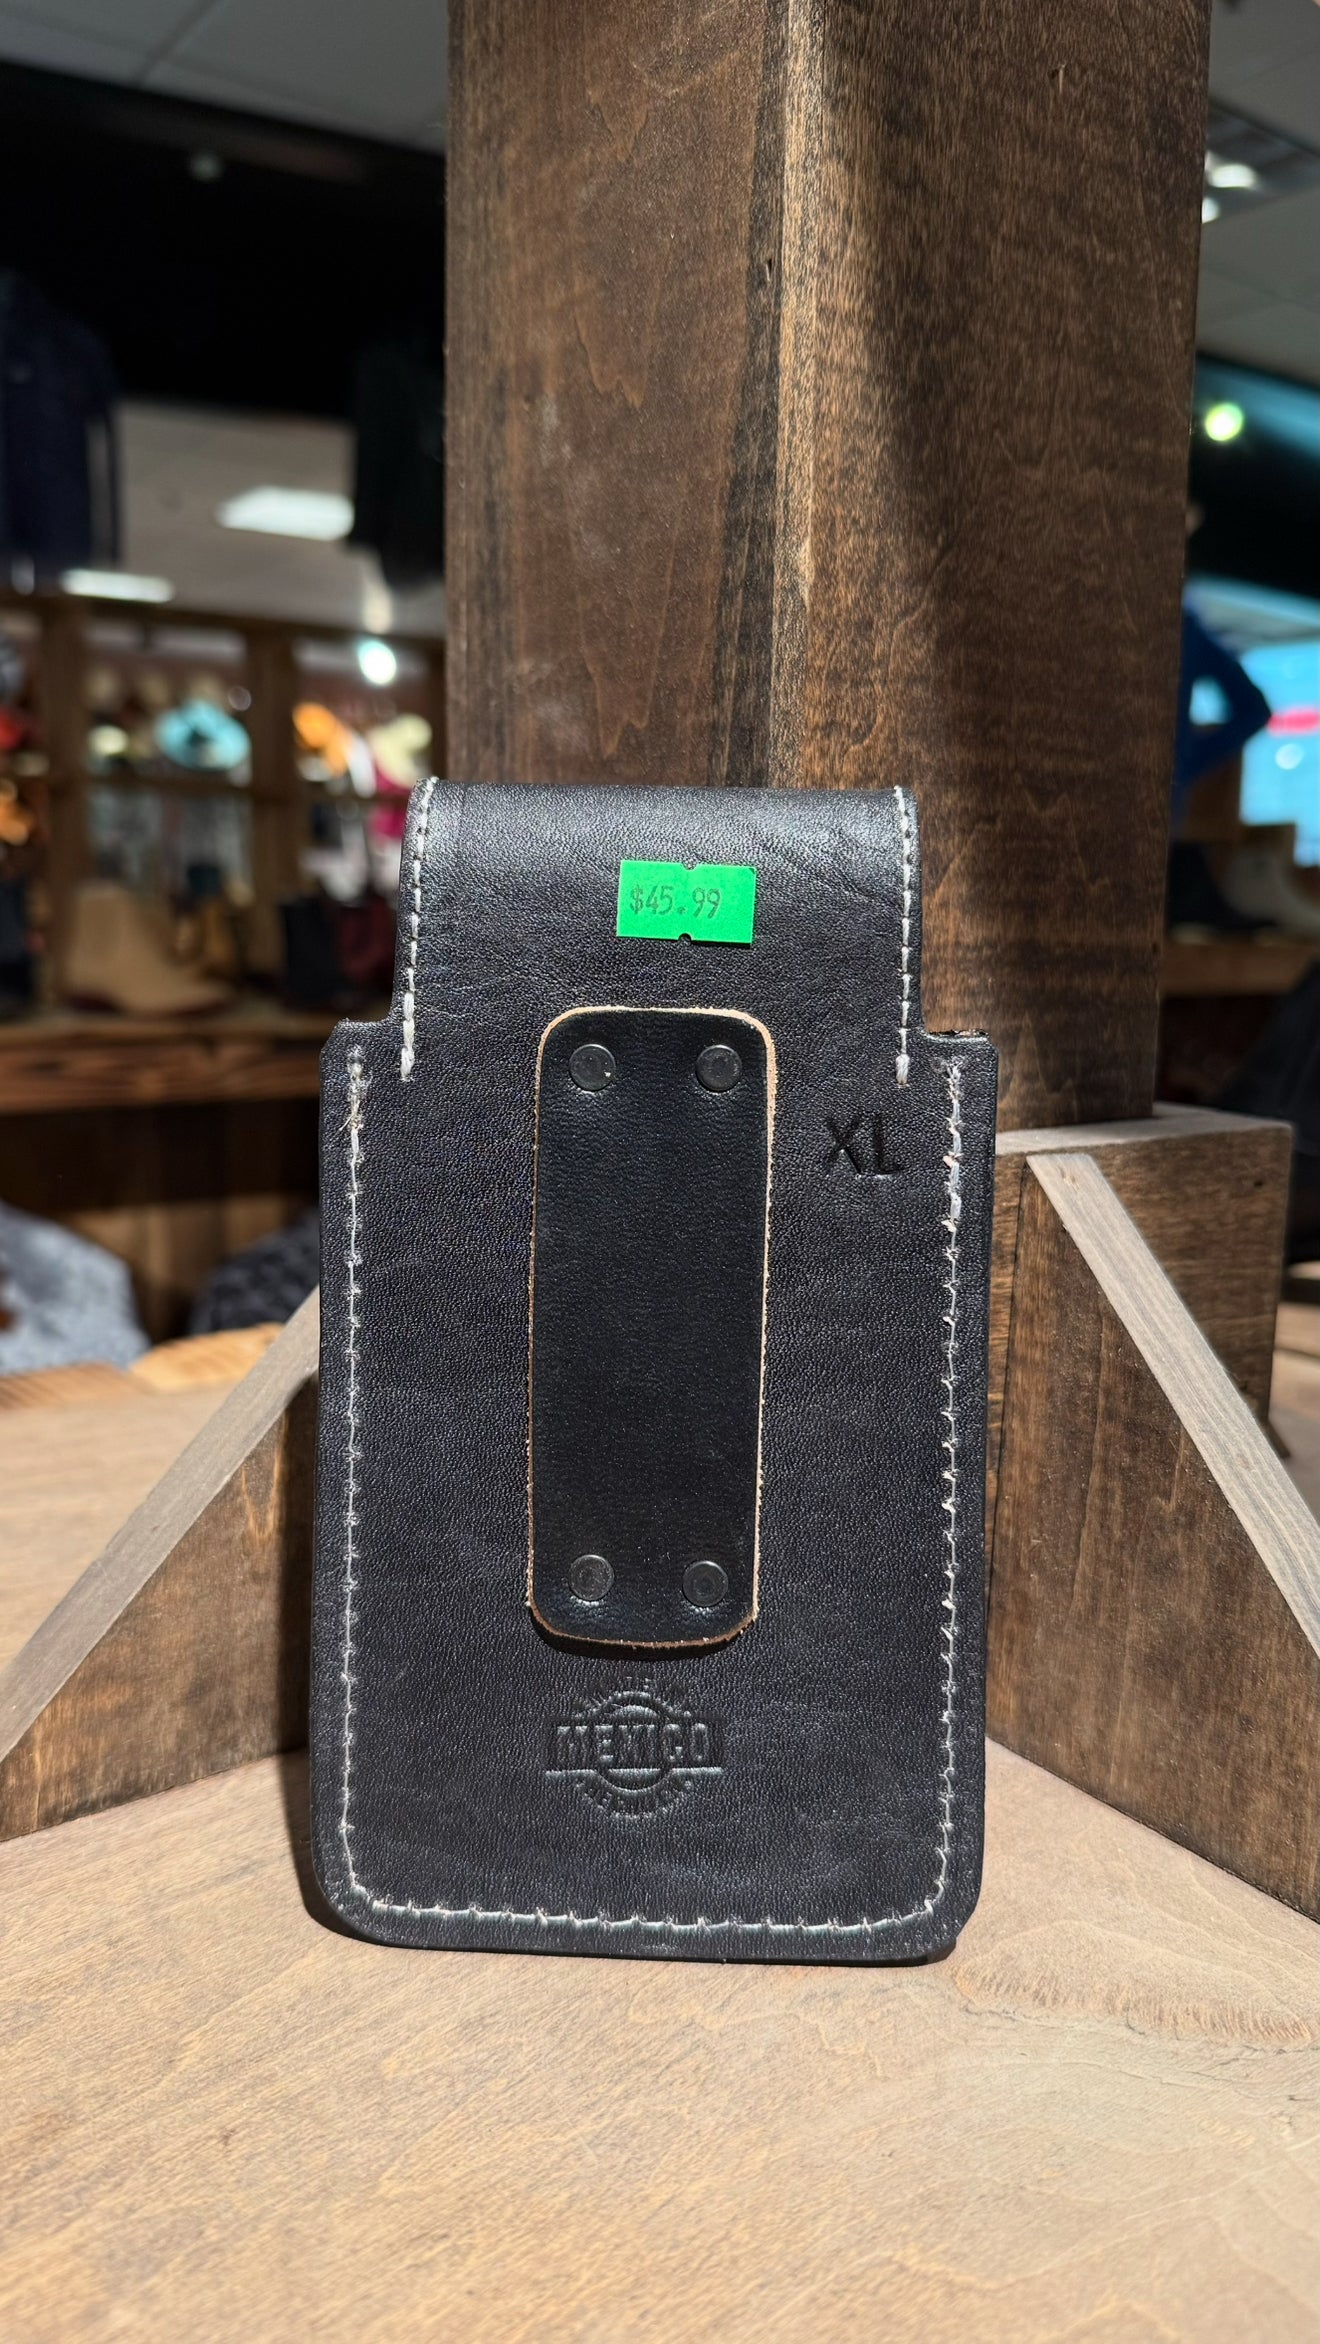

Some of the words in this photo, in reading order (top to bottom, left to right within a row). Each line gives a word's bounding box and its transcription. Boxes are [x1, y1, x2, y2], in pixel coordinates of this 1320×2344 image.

[629, 884, 721, 919] $45.99
[824, 1115, 904, 1177] XL
[556, 1722, 710, 1764] MEXICO
